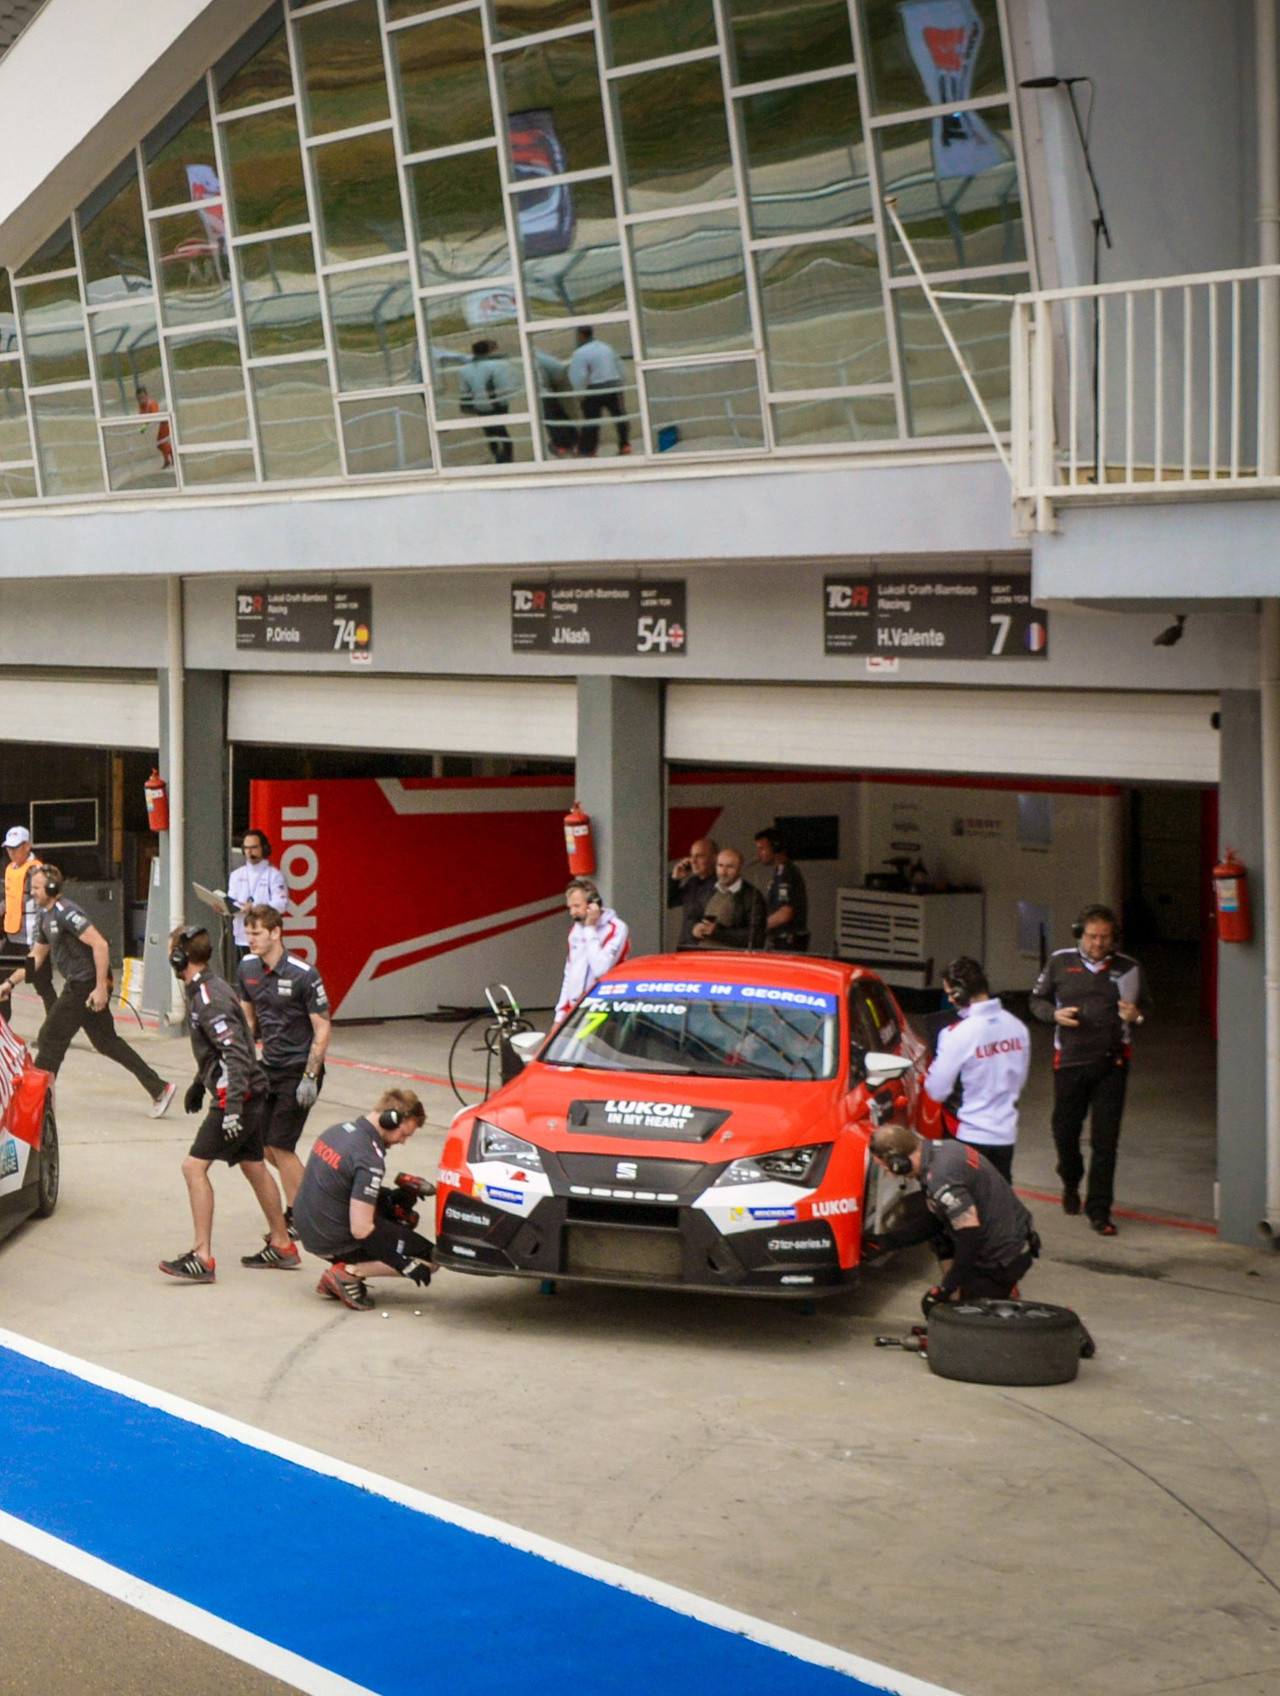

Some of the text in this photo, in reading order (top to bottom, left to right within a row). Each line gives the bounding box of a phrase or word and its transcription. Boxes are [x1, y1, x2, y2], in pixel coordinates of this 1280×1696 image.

[826, 585, 869, 609] TCR
[877, 584, 978, 597] Lukoil Craft-Bamboo
[238, 594, 263, 613] TCR
[513, 590, 546, 611] TCR
[551, 602, 578, 613] Racing
[877, 599, 911, 612] Racing
[266, 627, 300, 642] P.Oriola
[333, 618, 356, 650] 74
[552, 627, 590, 644] J.Nash
[637, 616, 669, 652] 54
[877, 627, 945, 647] H.Valente
[990, 614, 1012, 655] 7
[280, 794, 318, 966] UKOIL
[636, 982, 827, 1008] CHECK IN GEORGIA
[589, 1001, 686, 1015] H.Valente
[577, 1012, 608, 1039] 7
[976, 1038, 1022, 1059] LUKOIL
[604, 1100, 695, 1118] LUKOIL
[607, 1113, 687, 1129] IN MY HEART
[811, 1198, 858, 1217] LUKOIL
